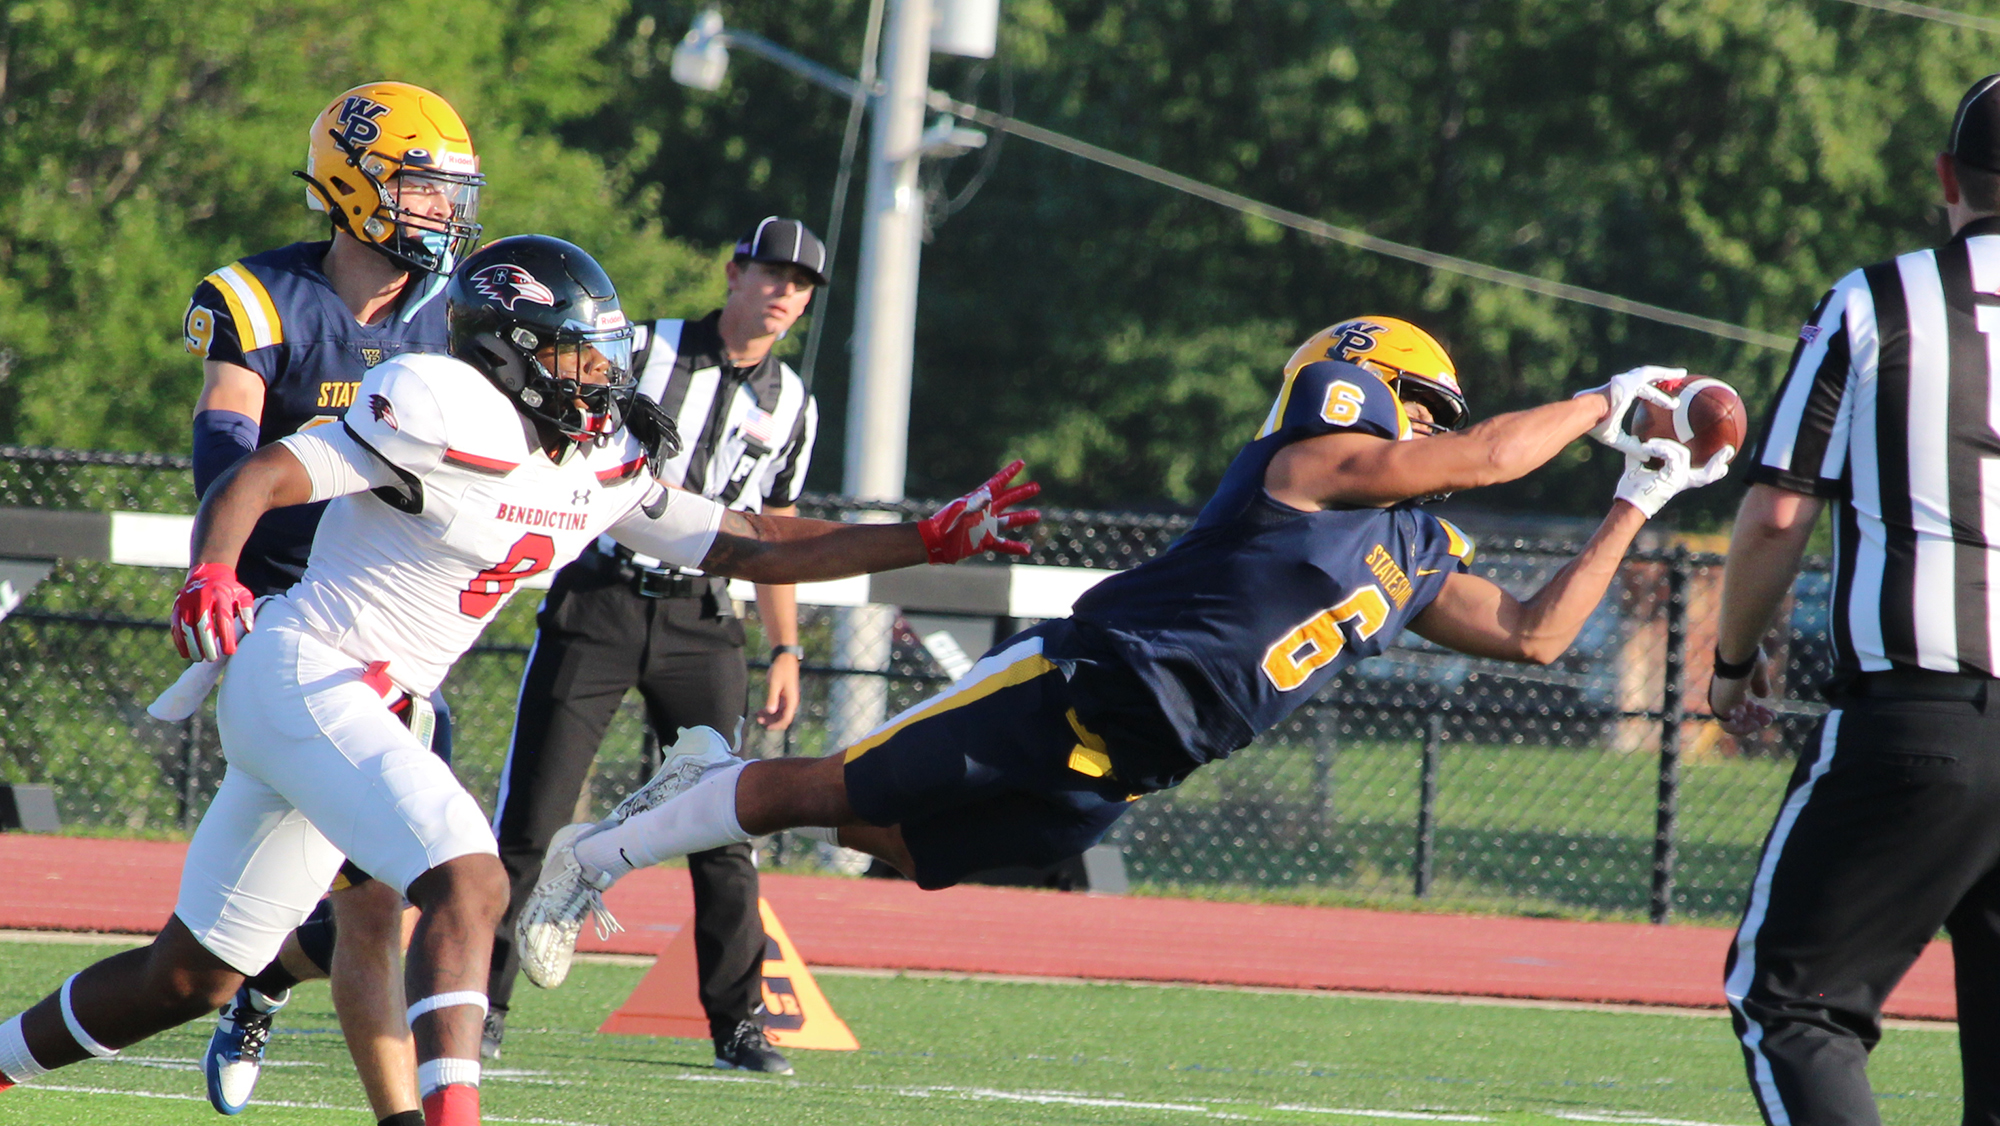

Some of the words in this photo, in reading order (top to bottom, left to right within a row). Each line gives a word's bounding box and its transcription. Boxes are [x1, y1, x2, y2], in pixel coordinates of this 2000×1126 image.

[183, 297, 215, 359] 9
[317, 381, 362, 408] STAT
[1320, 379, 1366, 428] 6
[494, 502, 588, 531] BENEDICTINE
[1261, 584, 1391, 692] 6
